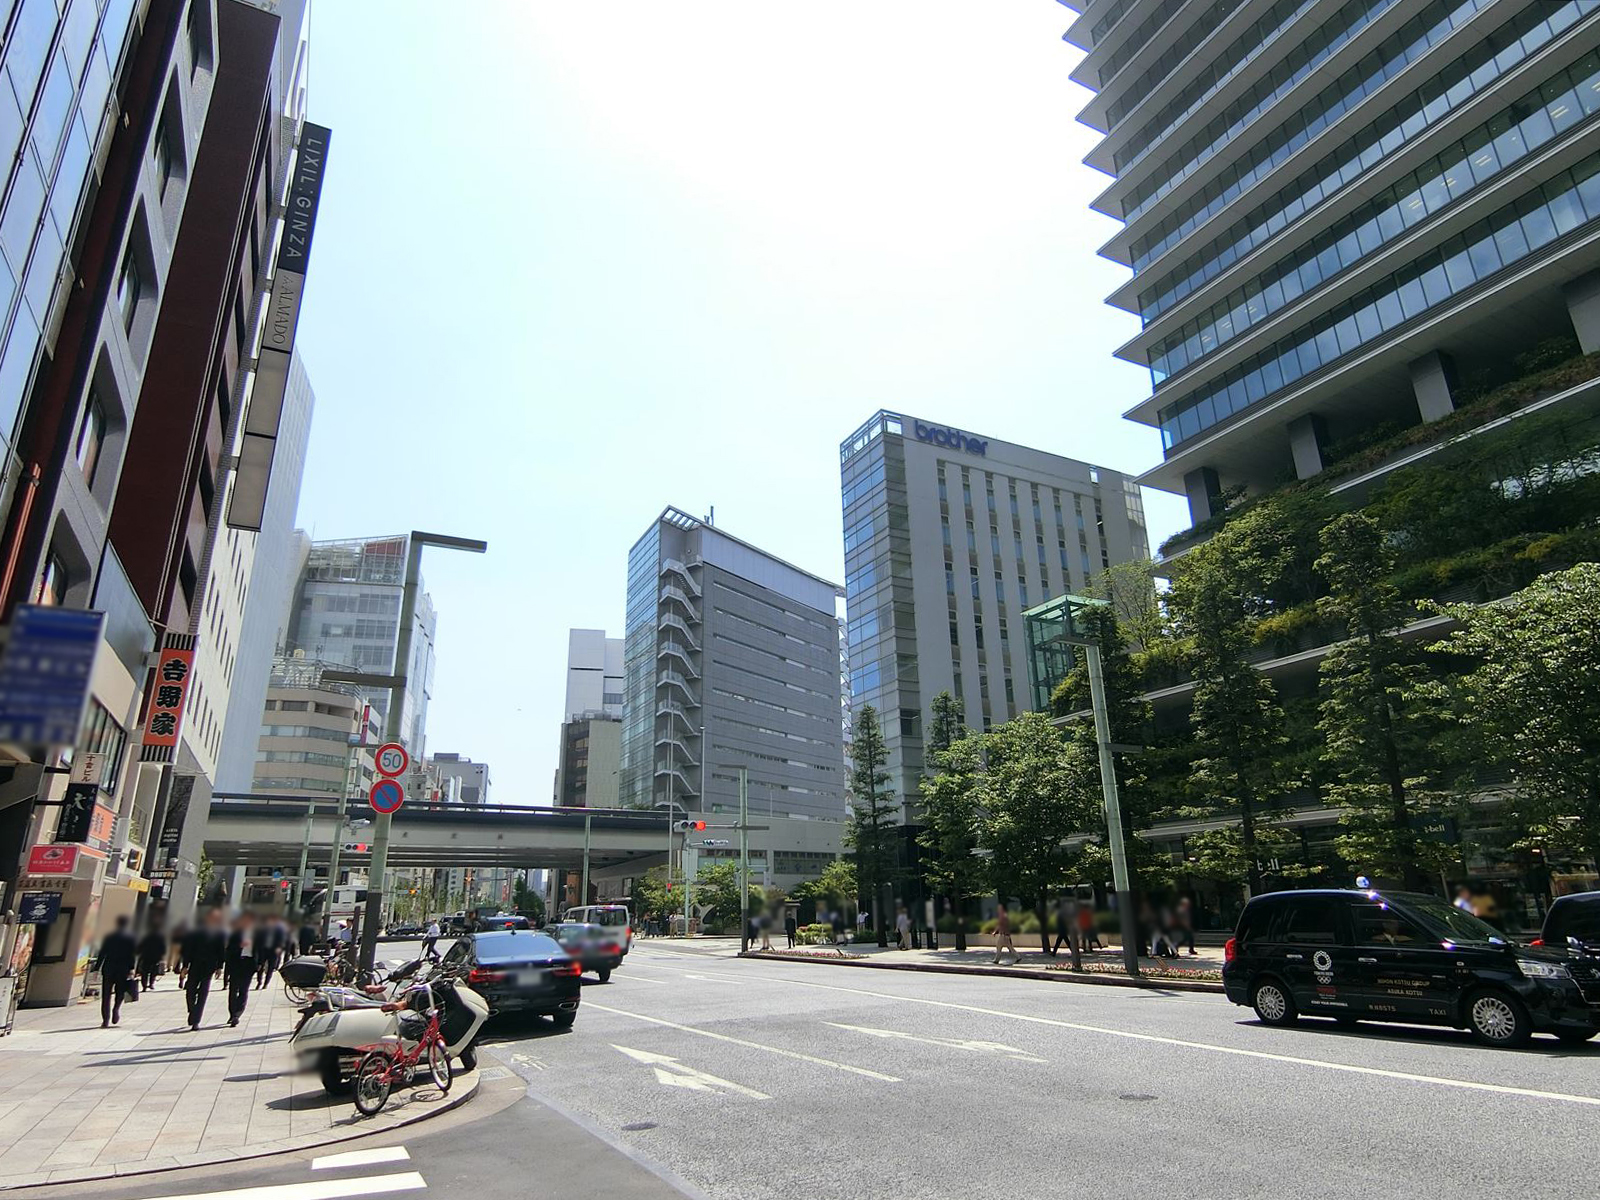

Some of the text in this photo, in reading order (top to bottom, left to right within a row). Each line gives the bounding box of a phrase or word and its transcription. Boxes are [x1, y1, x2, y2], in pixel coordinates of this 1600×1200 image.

[914, 419, 988, 456] brother
[150, 658, 188, 736] 吉野家
[382, 752, 402, 769] 50
[1429, 1008, 1447, 1016] TAXI
